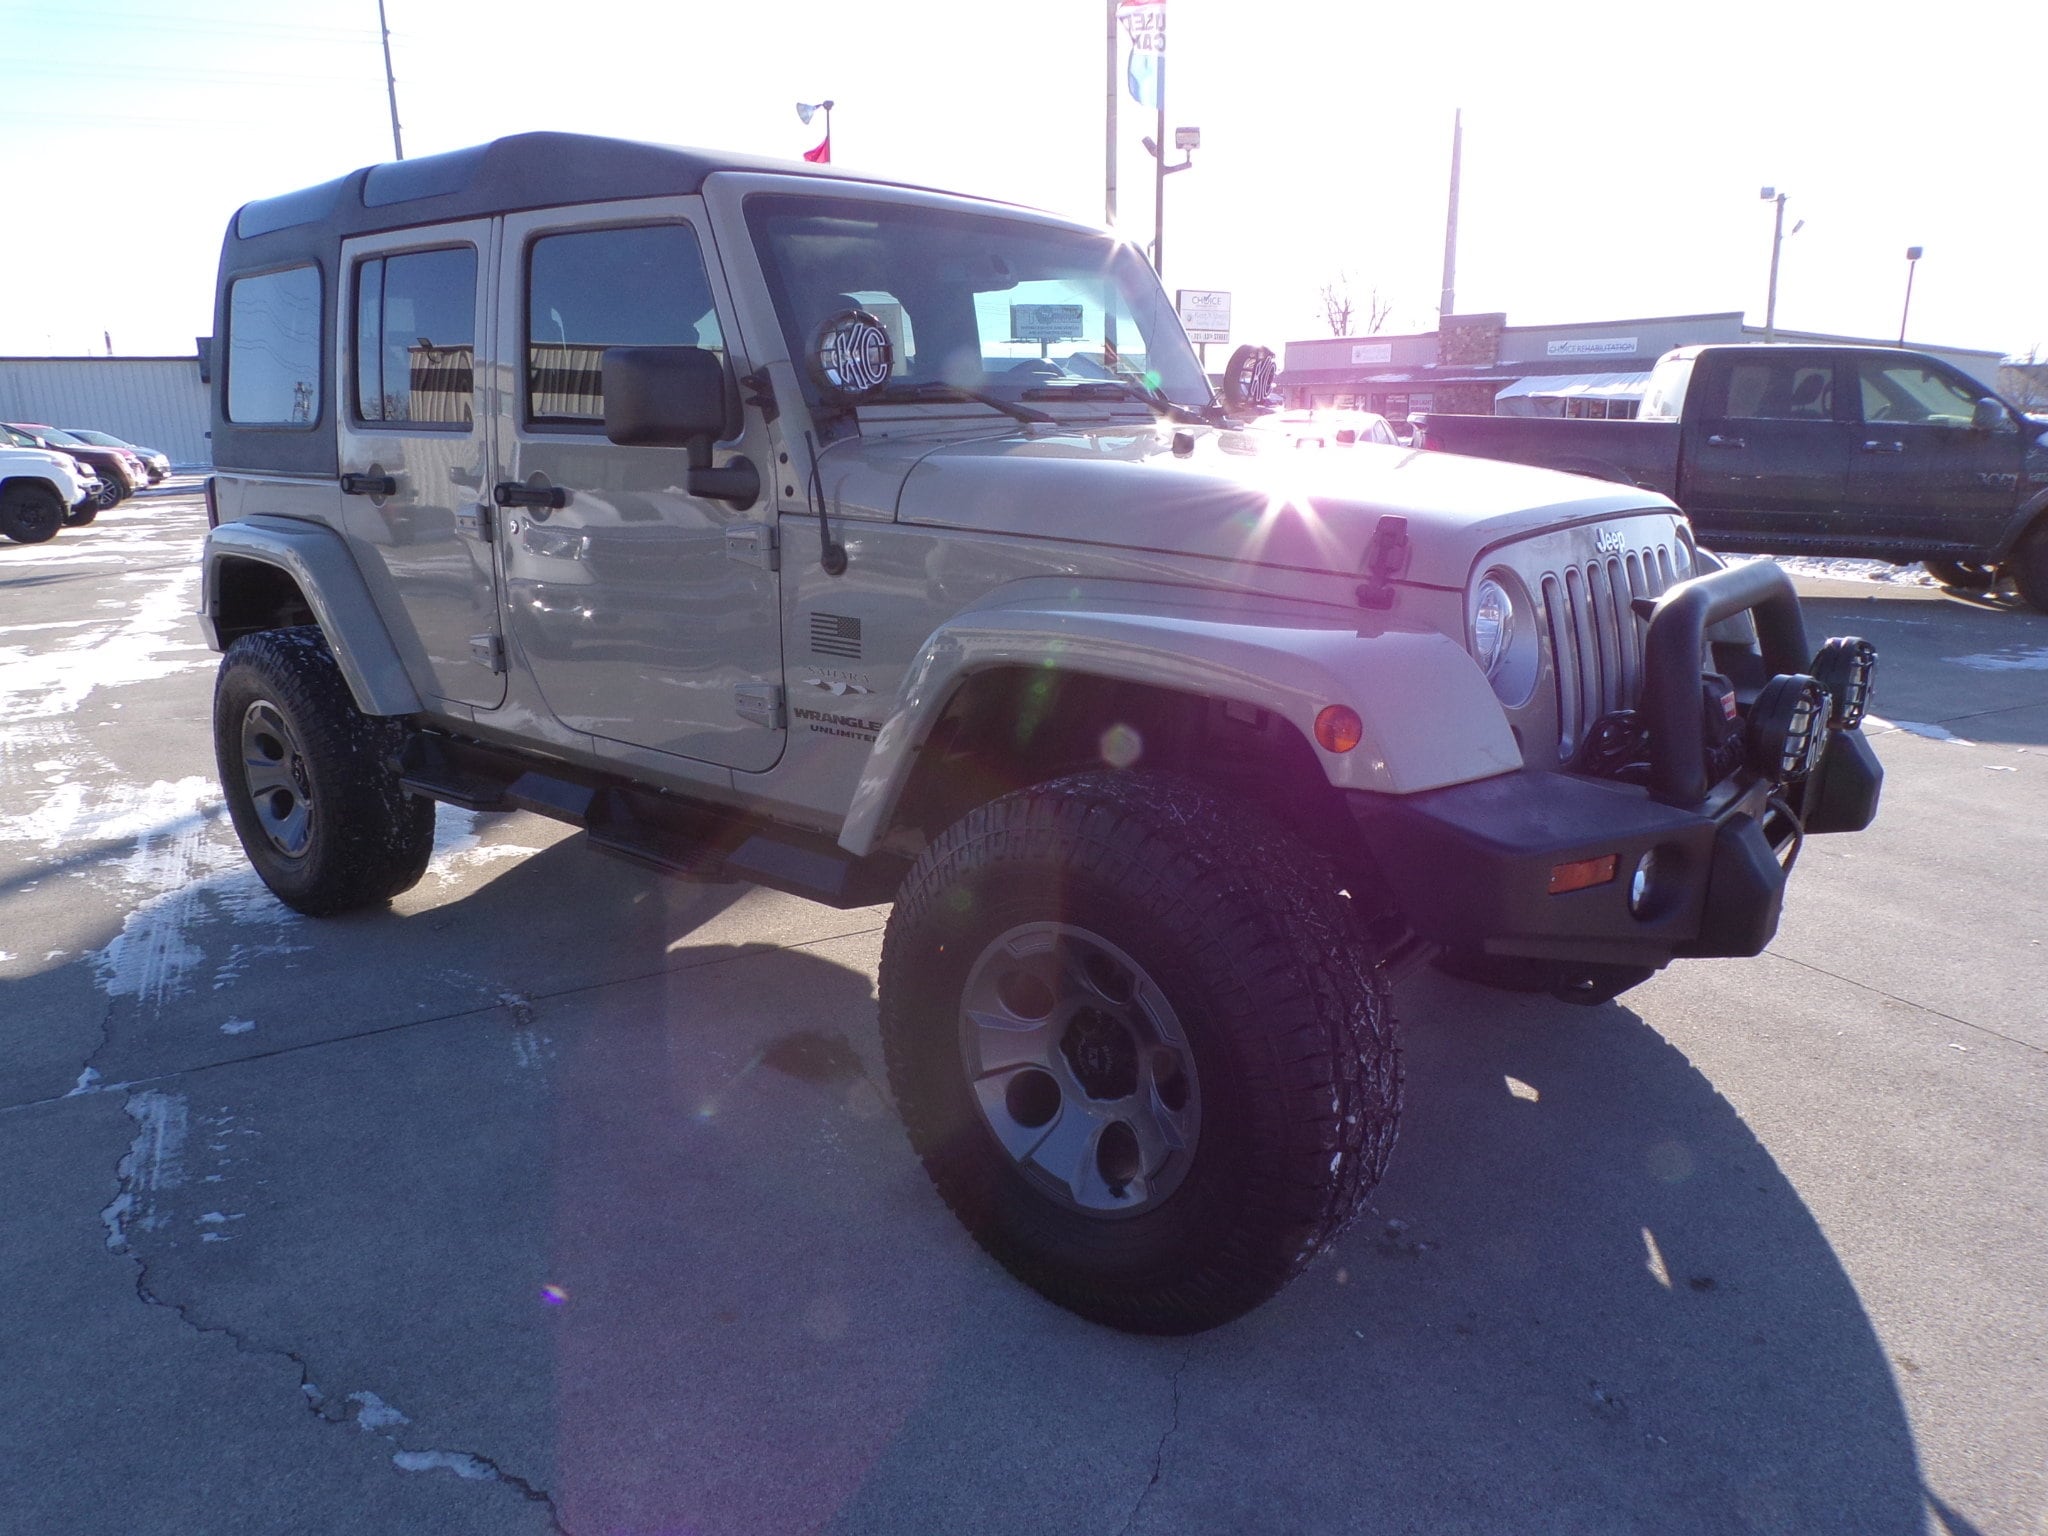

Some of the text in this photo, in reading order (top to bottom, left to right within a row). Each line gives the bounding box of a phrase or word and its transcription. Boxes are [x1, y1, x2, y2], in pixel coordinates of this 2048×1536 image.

[1191, 295, 1222, 305] CHOICE
[837, 323, 888, 390] KC
[1250, 355, 1277, 402] KC
[1596, 528, 1626, 553] Jeep
